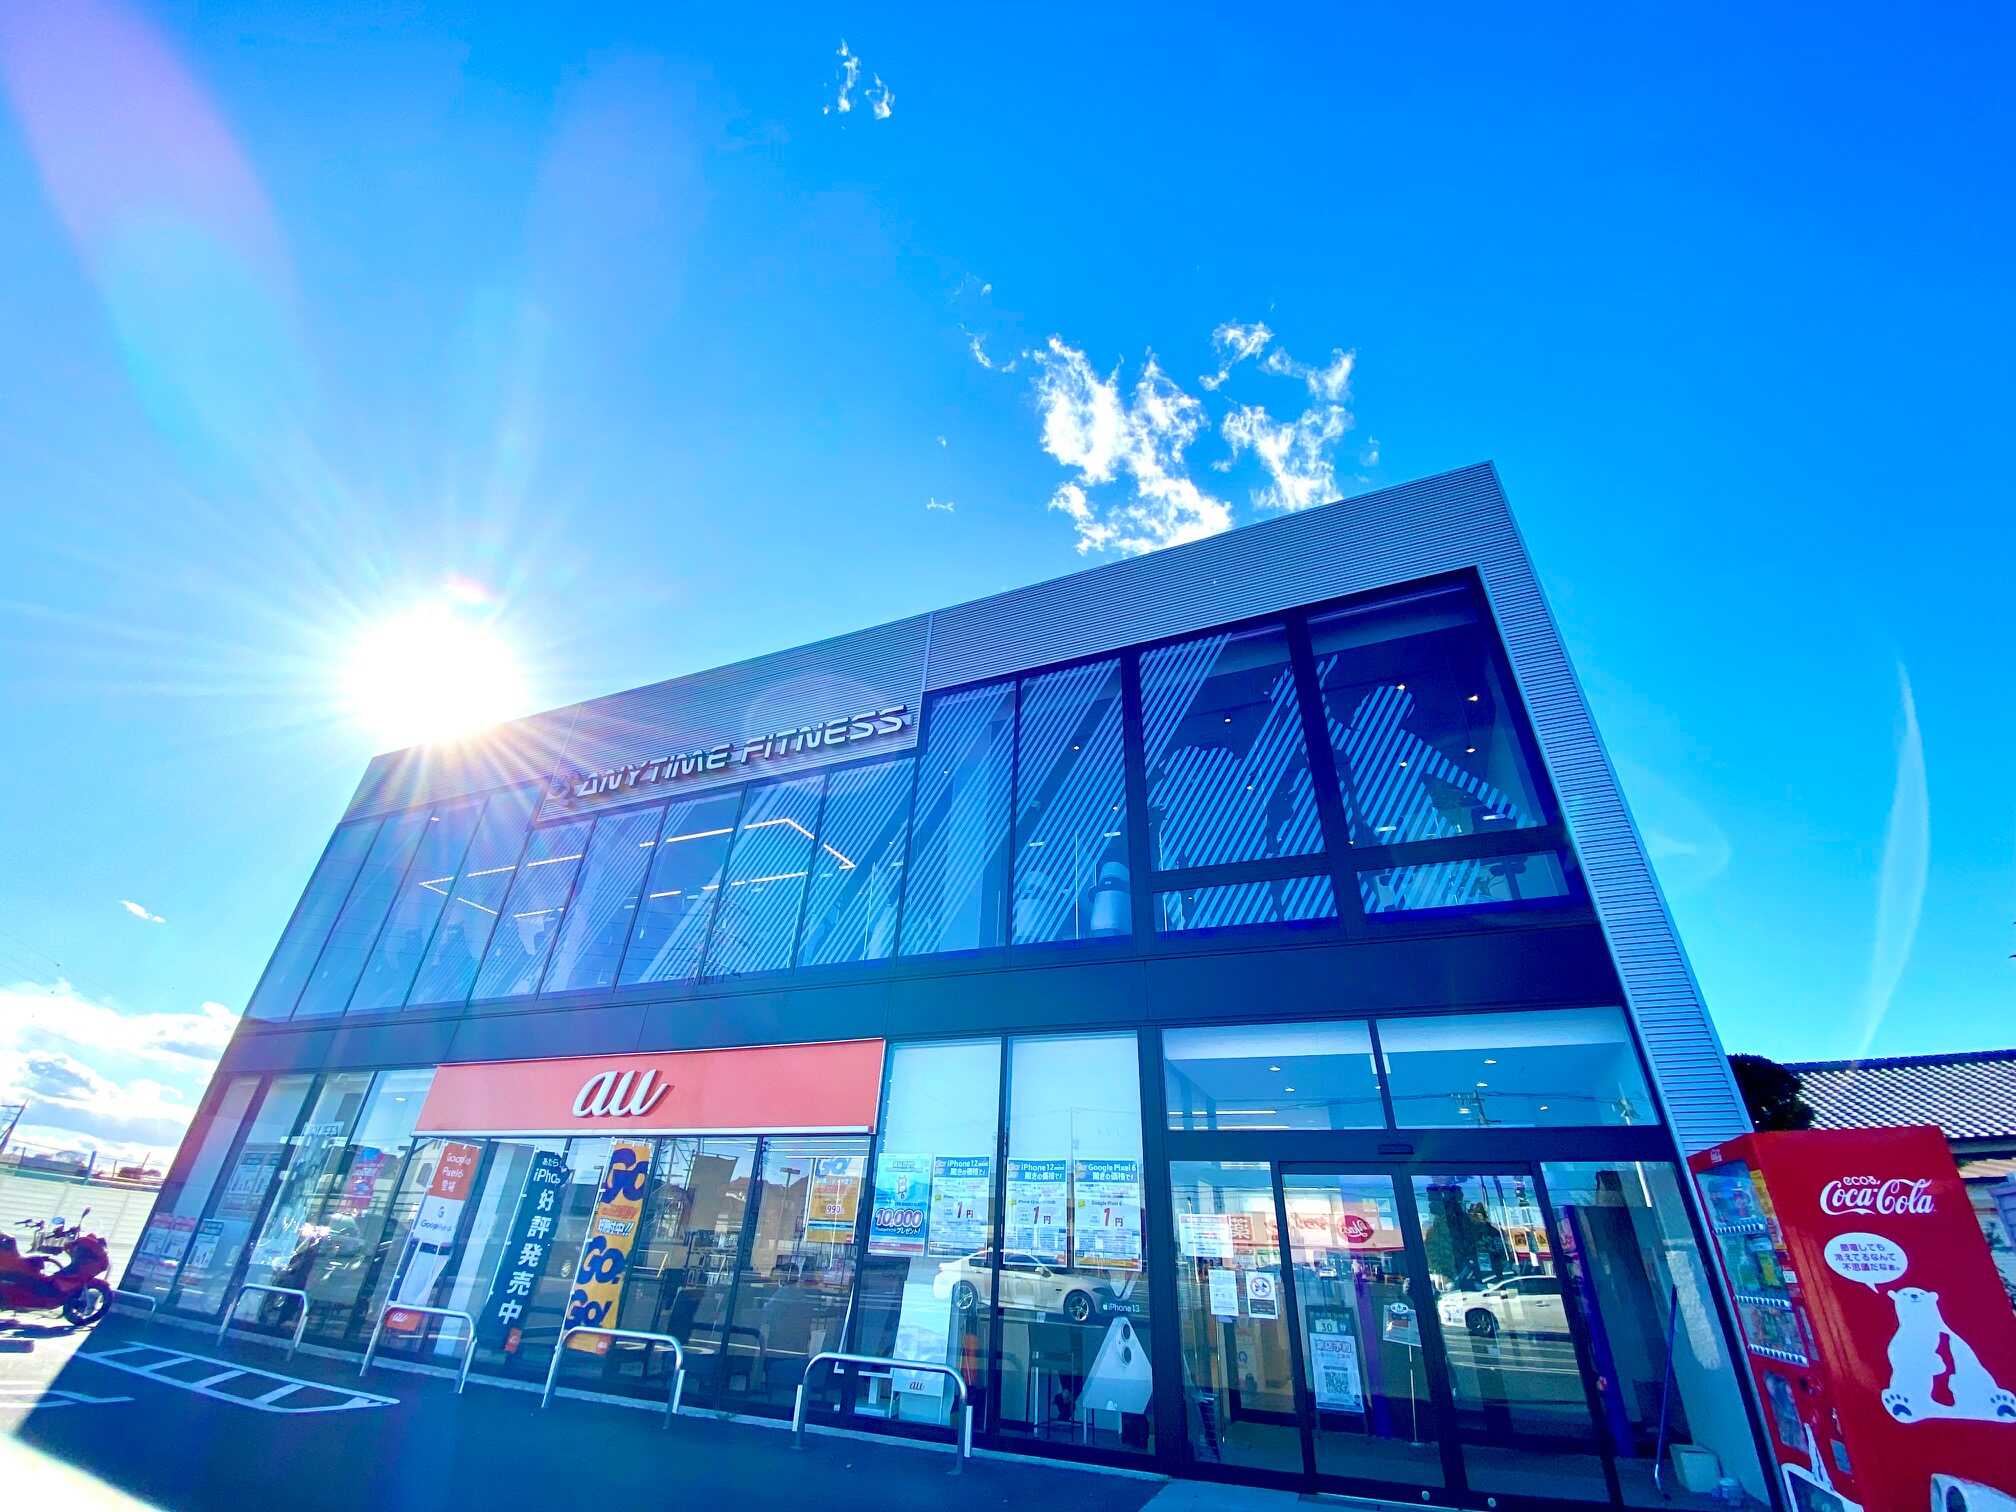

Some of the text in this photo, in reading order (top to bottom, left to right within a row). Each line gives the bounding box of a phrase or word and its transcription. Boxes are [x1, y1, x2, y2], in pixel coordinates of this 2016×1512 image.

[577, 705, 907, 796] ANYTIME FITNESS
[572, 1069, 670, 1117] au
[1088, 1164, 1112, 1172] Google
[876, 1208, 923, 1227] 10,000
[1820, 1178, 1936, 1215] Coca-Cola
[498, 1188, 554, 1325] 好評発売中
